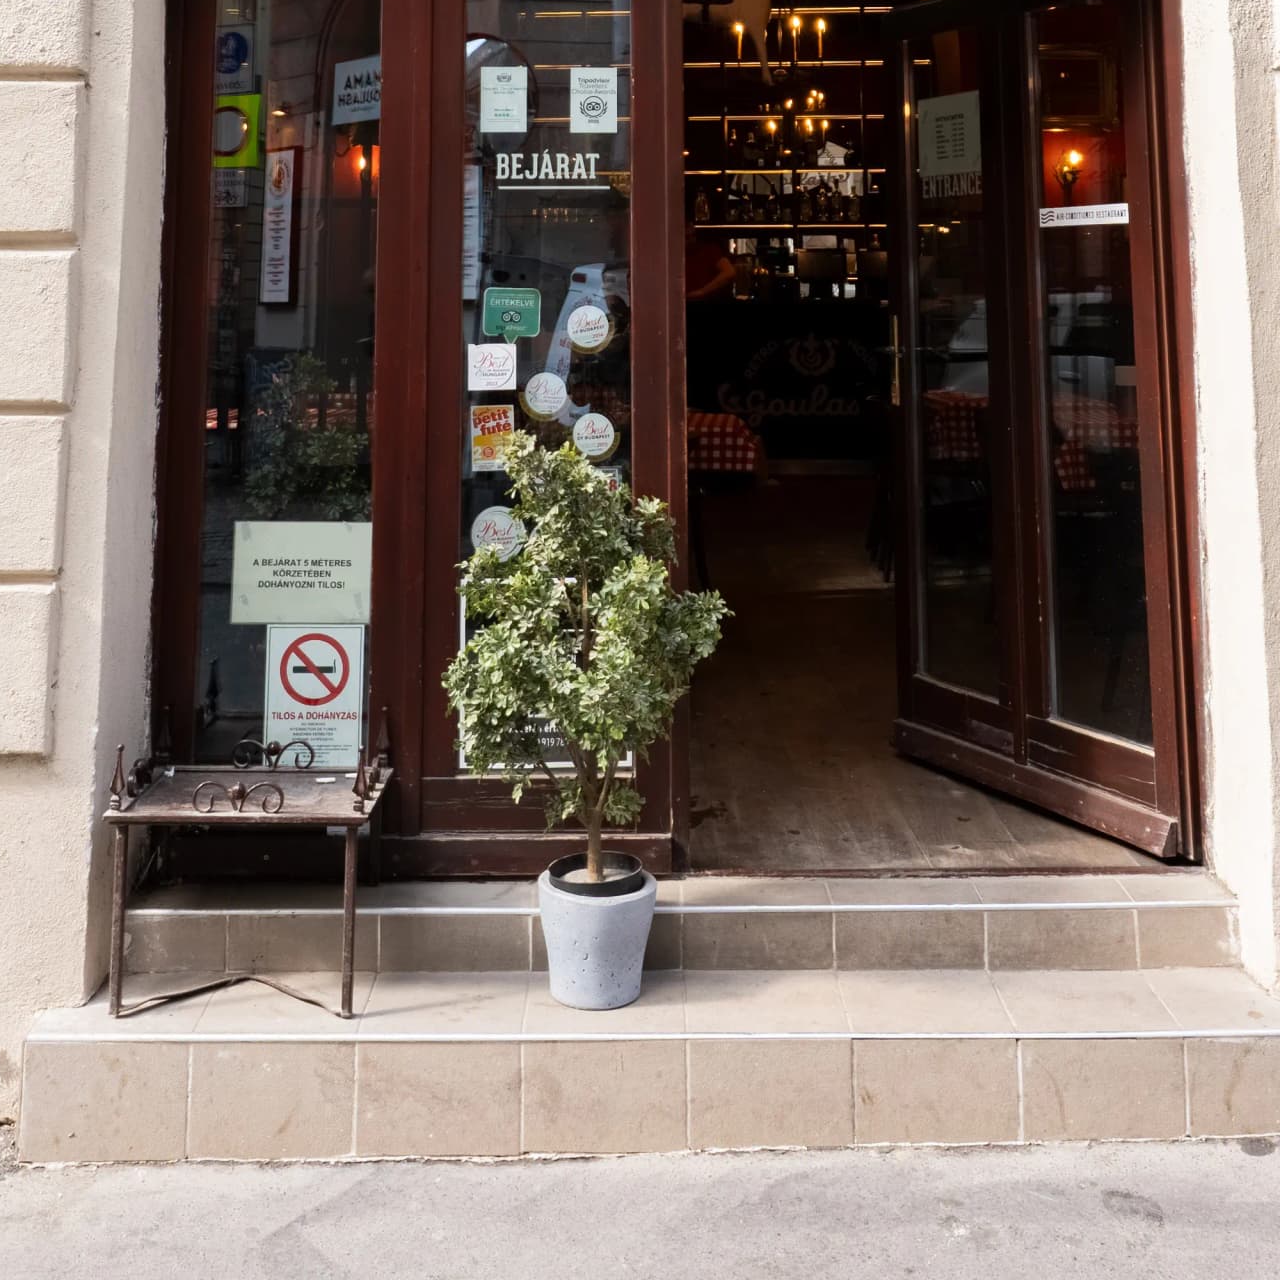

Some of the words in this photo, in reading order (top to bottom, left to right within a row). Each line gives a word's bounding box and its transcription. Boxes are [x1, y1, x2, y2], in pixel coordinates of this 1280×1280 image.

[495, 149, 601, 180] BEJÁRAT
[921, 172, 983, 199] ENTRANCE
[472, 408, 510, 428] petit
[252, 559, 260, 567] A
[303, 559, 310, 567] 5
[317, 580, 345, 589] TILOS!
[271, 711, 296, 720] TILOS
[297, 711, 304, 720] A
